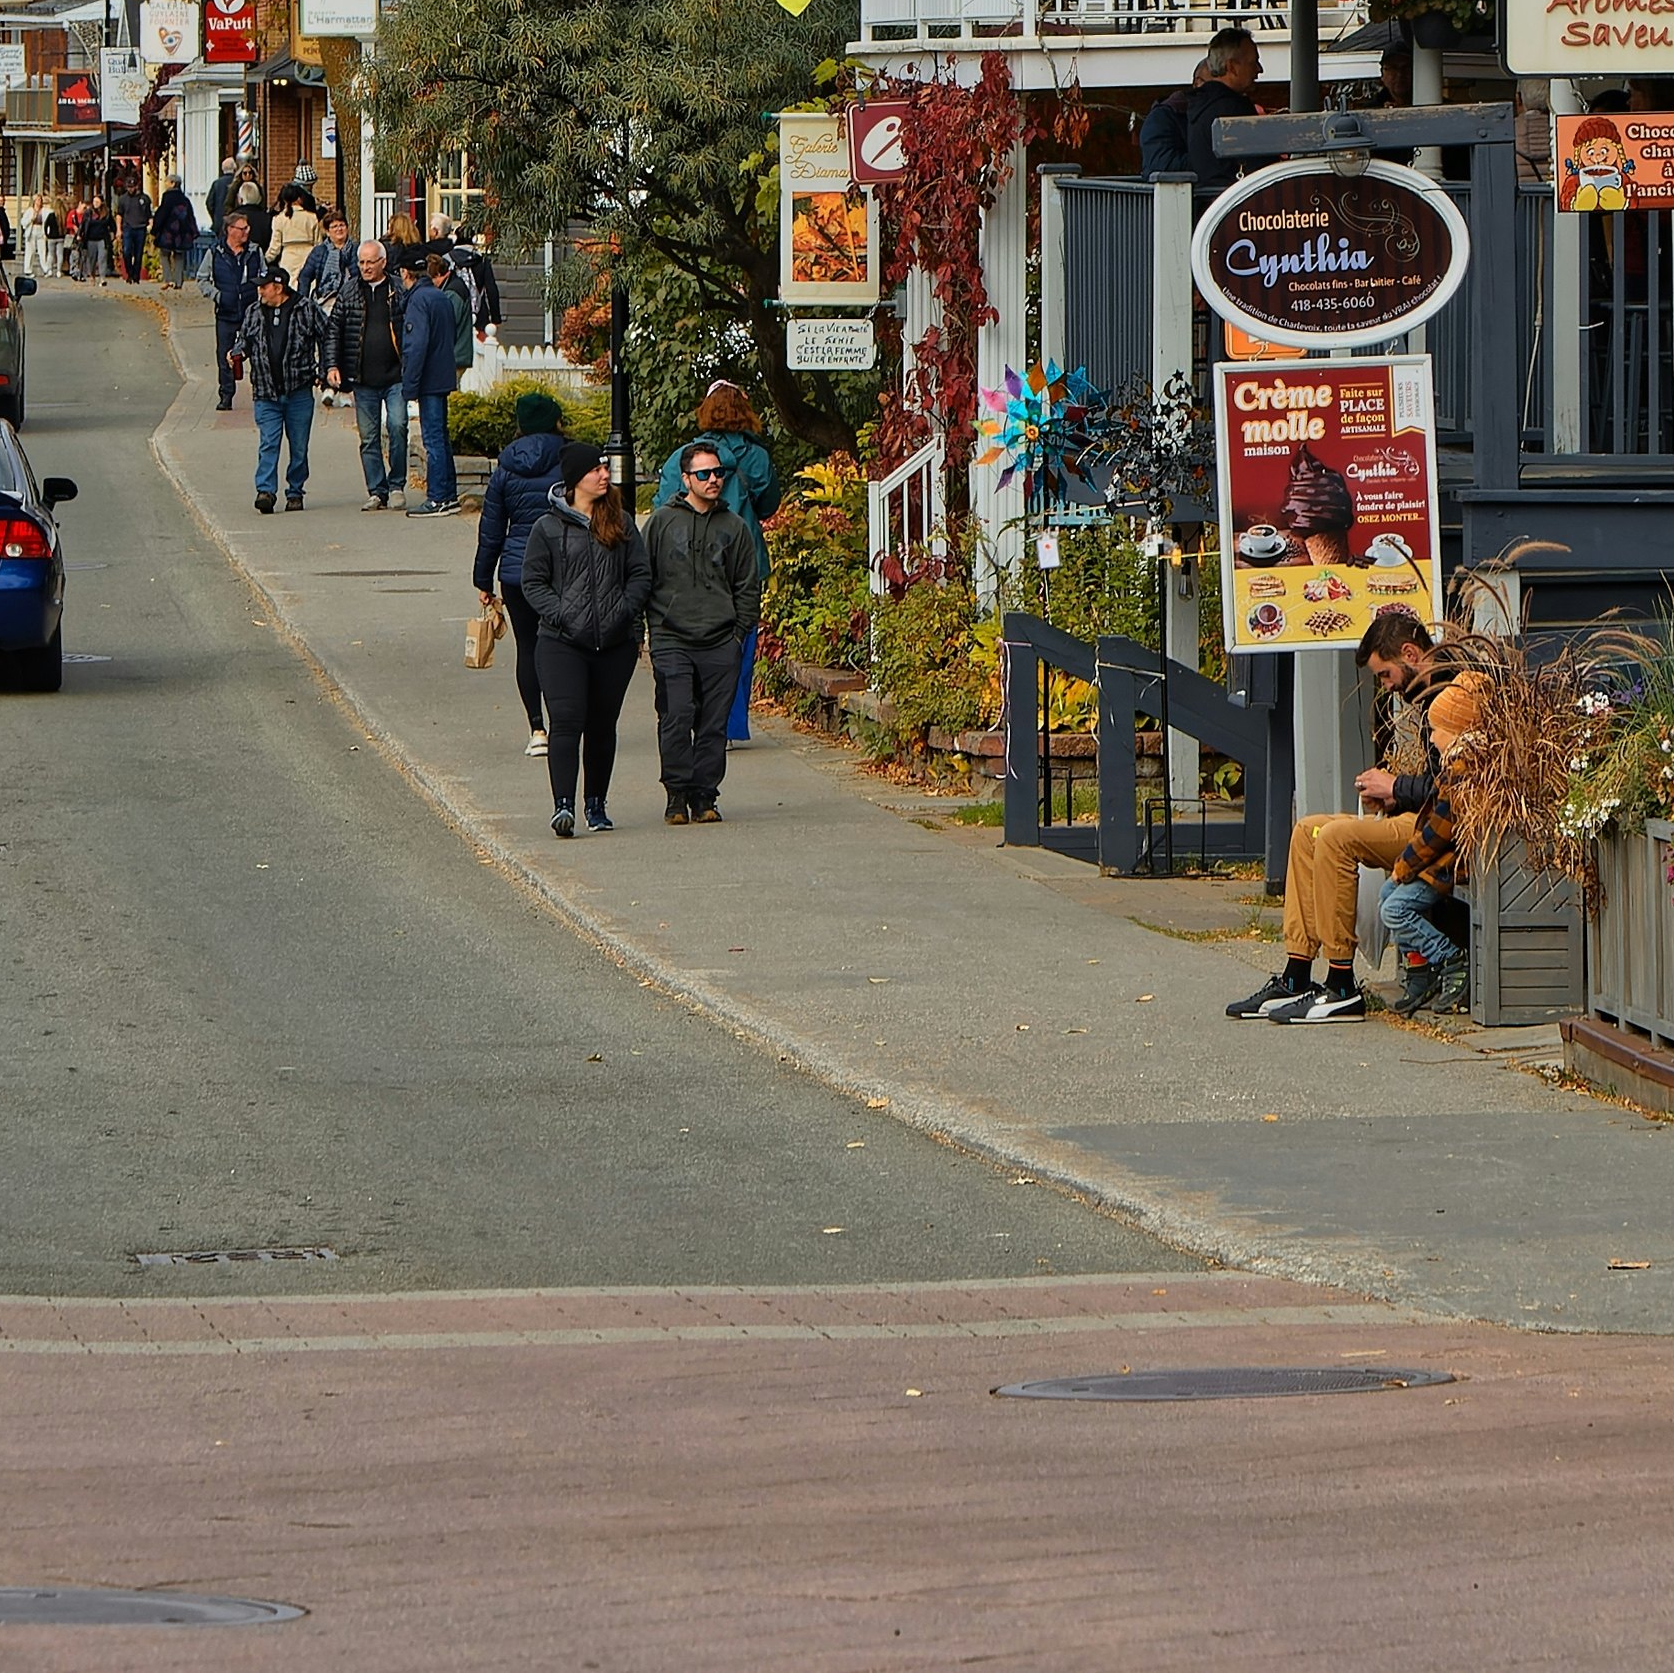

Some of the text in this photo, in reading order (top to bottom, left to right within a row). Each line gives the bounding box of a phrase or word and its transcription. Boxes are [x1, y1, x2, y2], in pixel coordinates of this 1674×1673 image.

[208, 17, 252, 31] VaPuff
[307, 15, 373, 25] L'Harmattan
[784, 133, 839, 165] Galerie
[1663, 162, 1674, 177] à
[1239, 207, 1330, 232] Chocolaterie
[1226, 232, 1375, 288] Cynthia
[1288, 280, 1331, 292] Chocolats
[1332, 279, 1348, 289] fins
[1354, 278, 1369, 288] Bar
[1402, 274, 1422, 286] Café
[1222, 286, 1237, 300] Une
[1235, 297, 1268, 321] tradition
[1268, 314, 1279, 325] de
[1278, 317, 1324, 333] Charlevoix,
[1324, 324, 1347, 332] toute
[1347, 322, 1356, 330] la
[1356, 317, 1381, 329] saveur
[1382, 311, 1393, 321] du
[1392, 300, 1413, 316] VRAI
[1410, 281, 1439, 306] chocolat
[1290, 294, 1376, 313] 418-435-6060
[805, 336, 817, 345] LE
[835, 346, 868, 358] FEMME
[1233, 378, 1333, 412] Crème
[1339, 389, 1384, 399] Faite sur
[1340, 399, 1385, 413] PLACE
[1340, 413, 1385, 425] de façon
[1241, 410, 1326, 444] molle
[1340, 424, 1387, 435] ARTISANALE
[1244, 444, 1291, 457] maison
[1346, 460, 1400, 482] Cynthia
[1356, 491, 1404, 501] À vous faire
[1357, 499, 1426, 513] fondre de plaisir!
[1357, 514, 1380, 524] OSEZ
